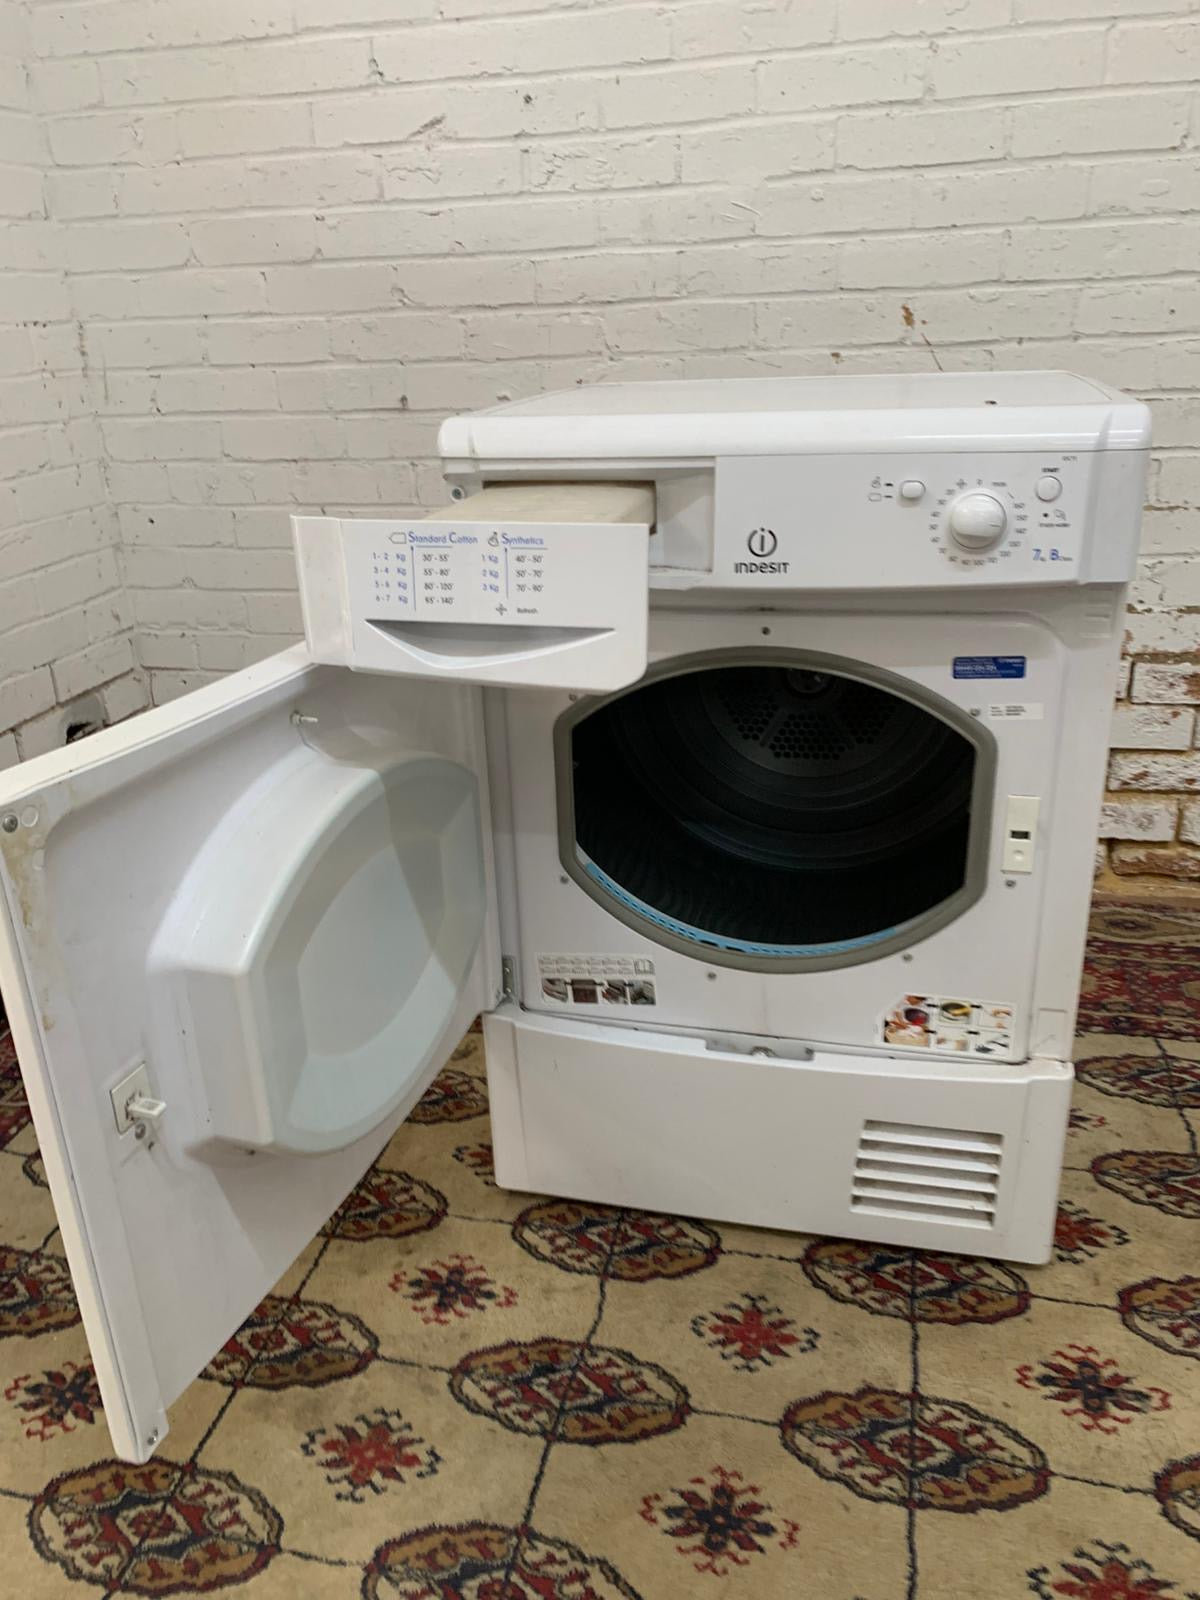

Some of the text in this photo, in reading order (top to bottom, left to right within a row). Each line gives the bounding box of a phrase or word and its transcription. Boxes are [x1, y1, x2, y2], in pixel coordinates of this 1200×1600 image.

[408, 531, 478, 545] Standard Cotton
[501, 532, 544, 546] Synthetics
